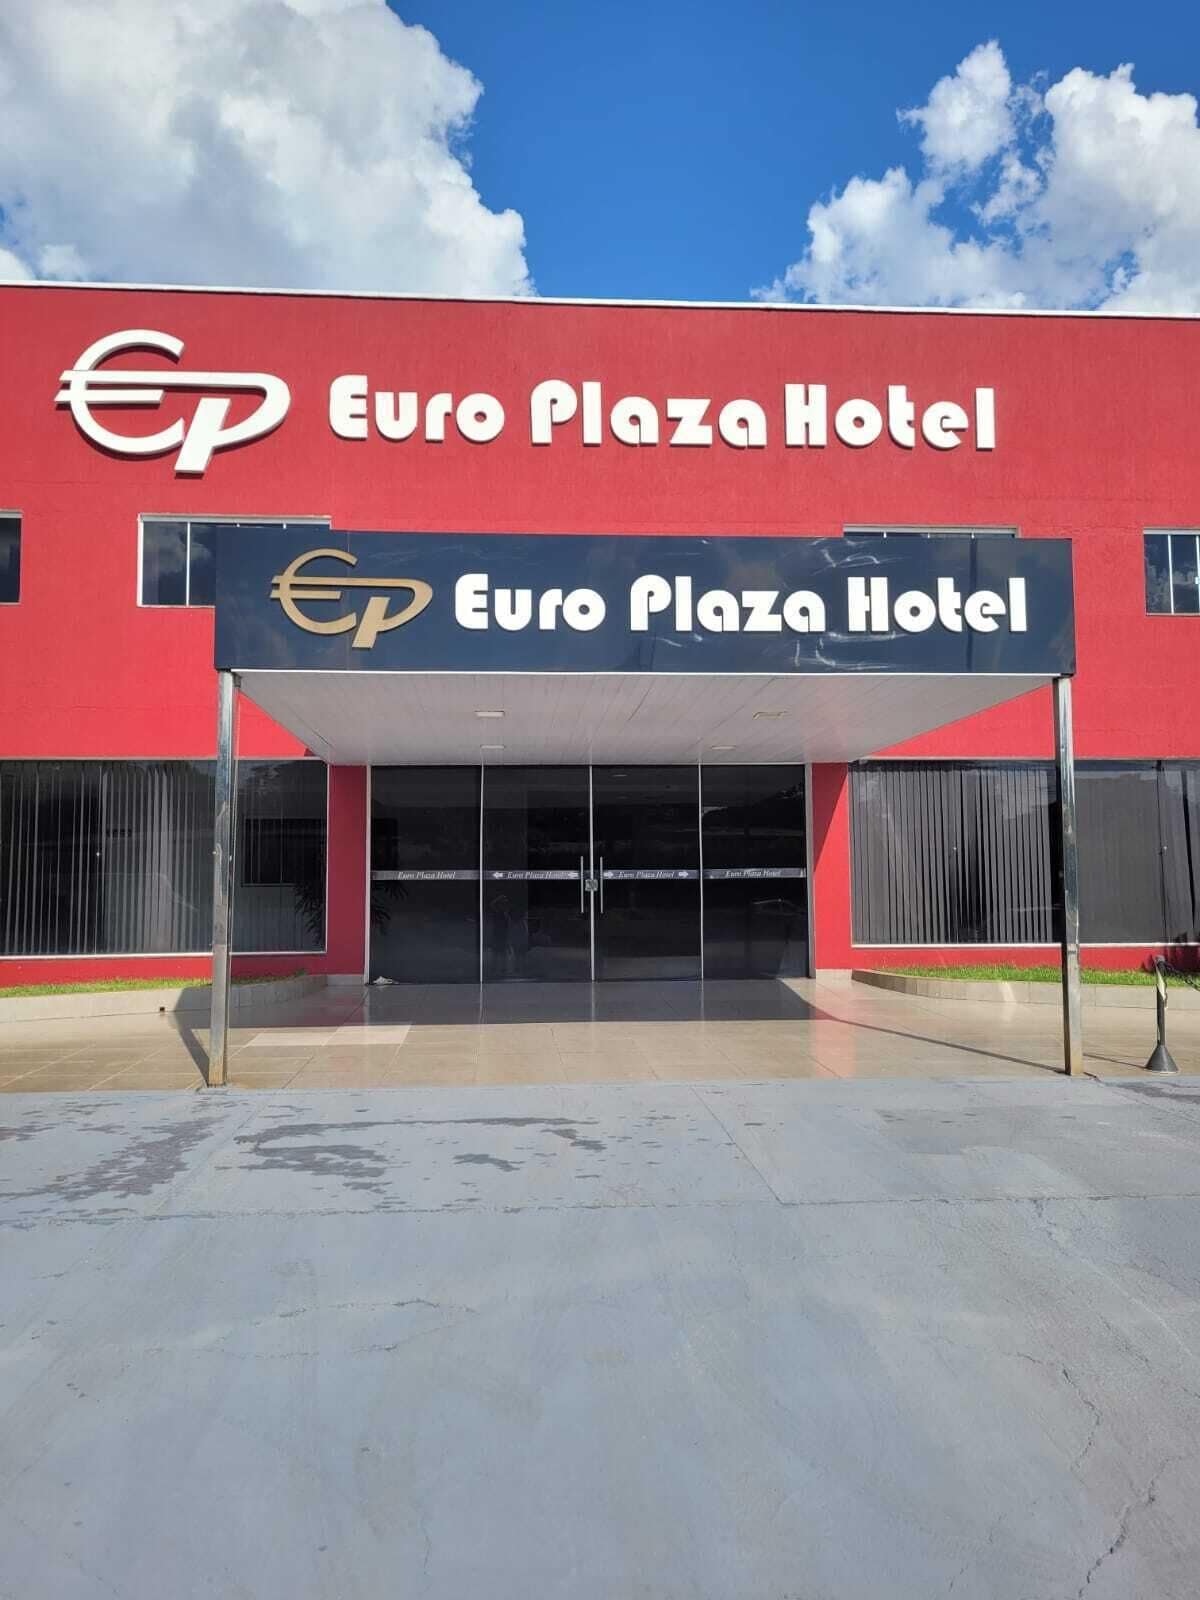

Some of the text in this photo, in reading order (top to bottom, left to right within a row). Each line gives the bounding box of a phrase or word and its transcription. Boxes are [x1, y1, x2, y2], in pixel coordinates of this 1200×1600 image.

[329, 374, 996, 450] Euro Plaza Hotel
[455, 573, 1027, 633] Euro Plaza Hotel
